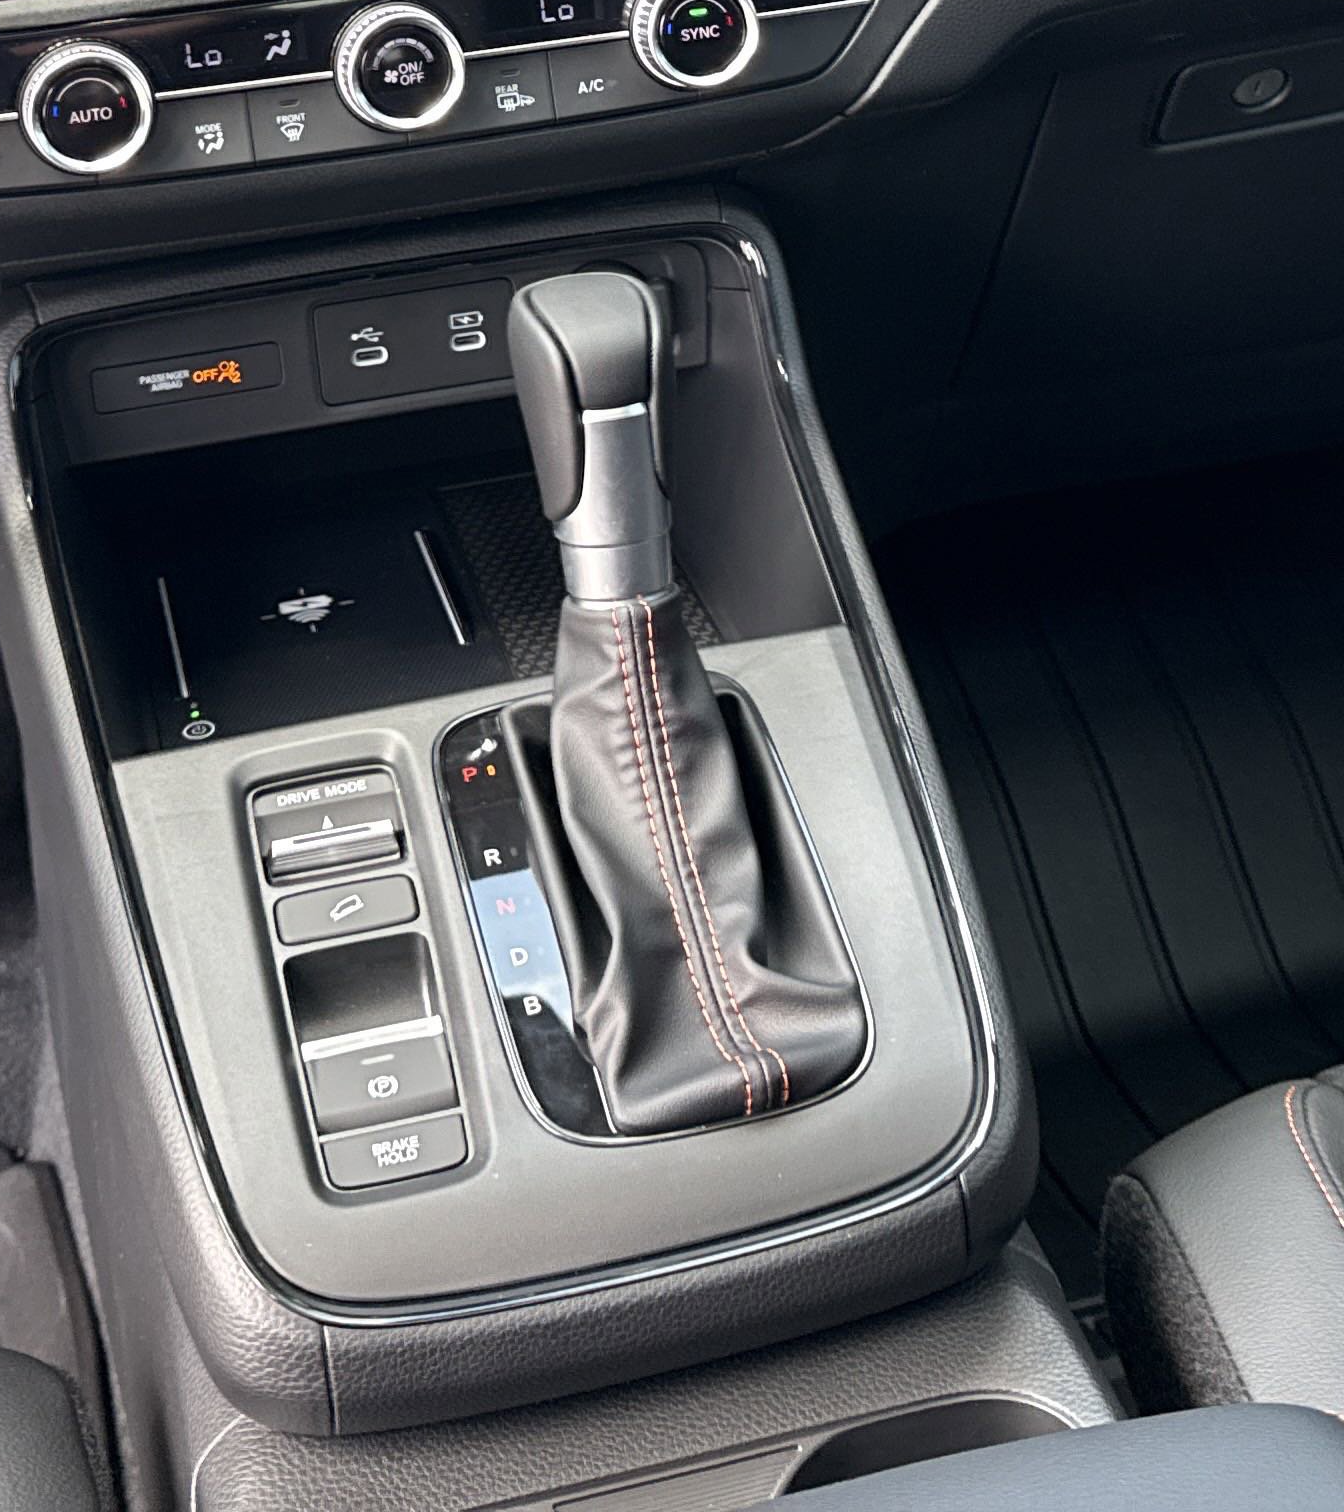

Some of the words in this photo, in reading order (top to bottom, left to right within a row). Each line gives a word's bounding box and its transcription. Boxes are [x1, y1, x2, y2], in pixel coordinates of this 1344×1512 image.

[680, 24, 721, 42] SYNC
[398, 61, 423, 74] ON/
[399, 73, 425, 86] OFF
[578, 78, 605, 95] A/C
[68, 106, 113, 125] AUTO
[276, 112, 306, 125] FRONT
[195, 122, 222, 135] MODE
[192, 368, 219, 384] OFF
[462, 766, 479, 783] P
[276, 788, 321, 807] DRIVE
[324, 778, 368, 798] MODE
[483, 848, 503, 867] R
[496, 897, 516, 916] N
[510, 946, 529, 967] D
[523, 995, 542, 1016] B
[371, 1134, 420, 1157] BRAKE
[377, 1147, 418, 1168] HOLD
